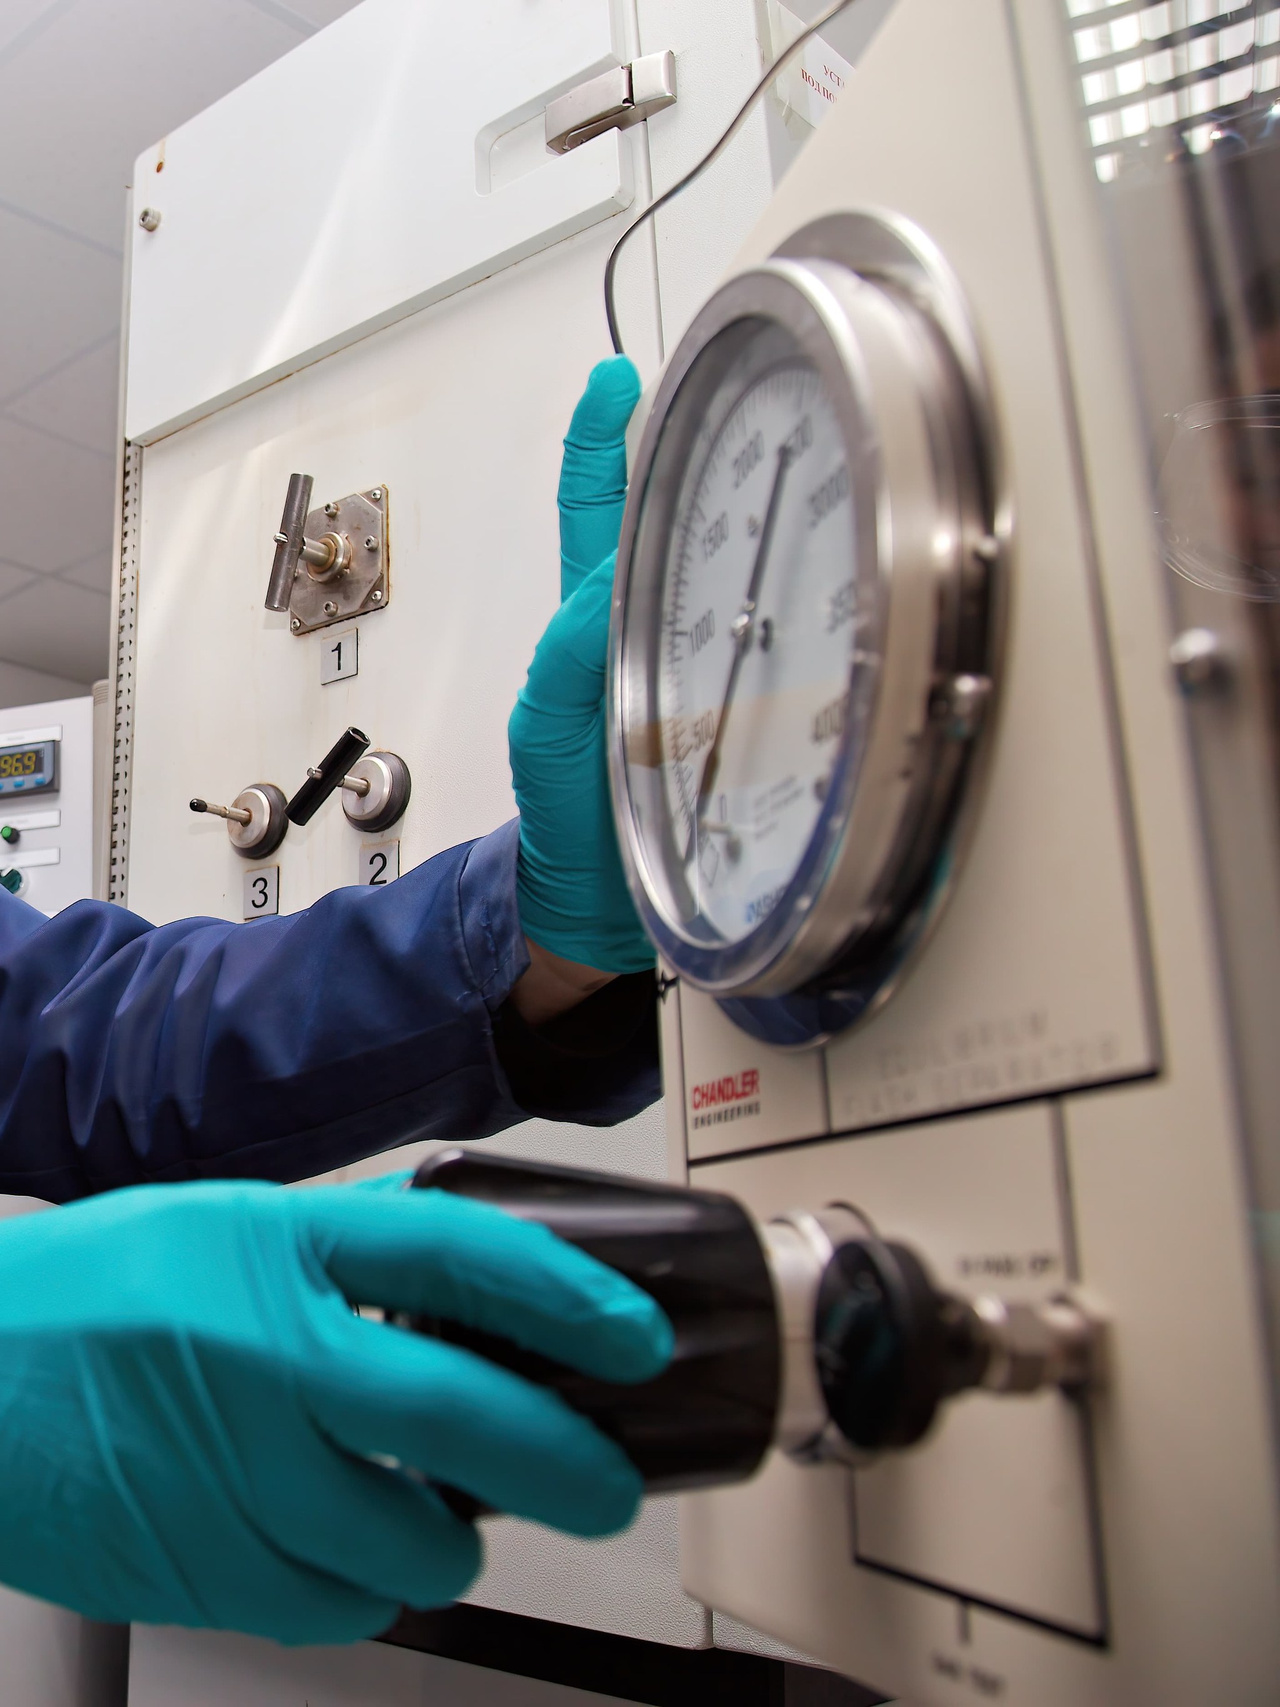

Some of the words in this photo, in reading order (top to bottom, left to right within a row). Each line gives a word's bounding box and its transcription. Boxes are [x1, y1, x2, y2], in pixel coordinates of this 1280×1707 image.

[823, 64, 845, 89] УСТ
[703, 511, 729, 564] 1500
[690, 608, 716, 657] 1000
[331, 641, 342, 671] 1
[693, 708, 716, 753] 500
[369, 852, 388, 886] 2
[251, 877, 269, 909] 3
[693, 1069, 759, 1111] CHANDLER
[694, 1101, 761, 1130] ENGINEERING
